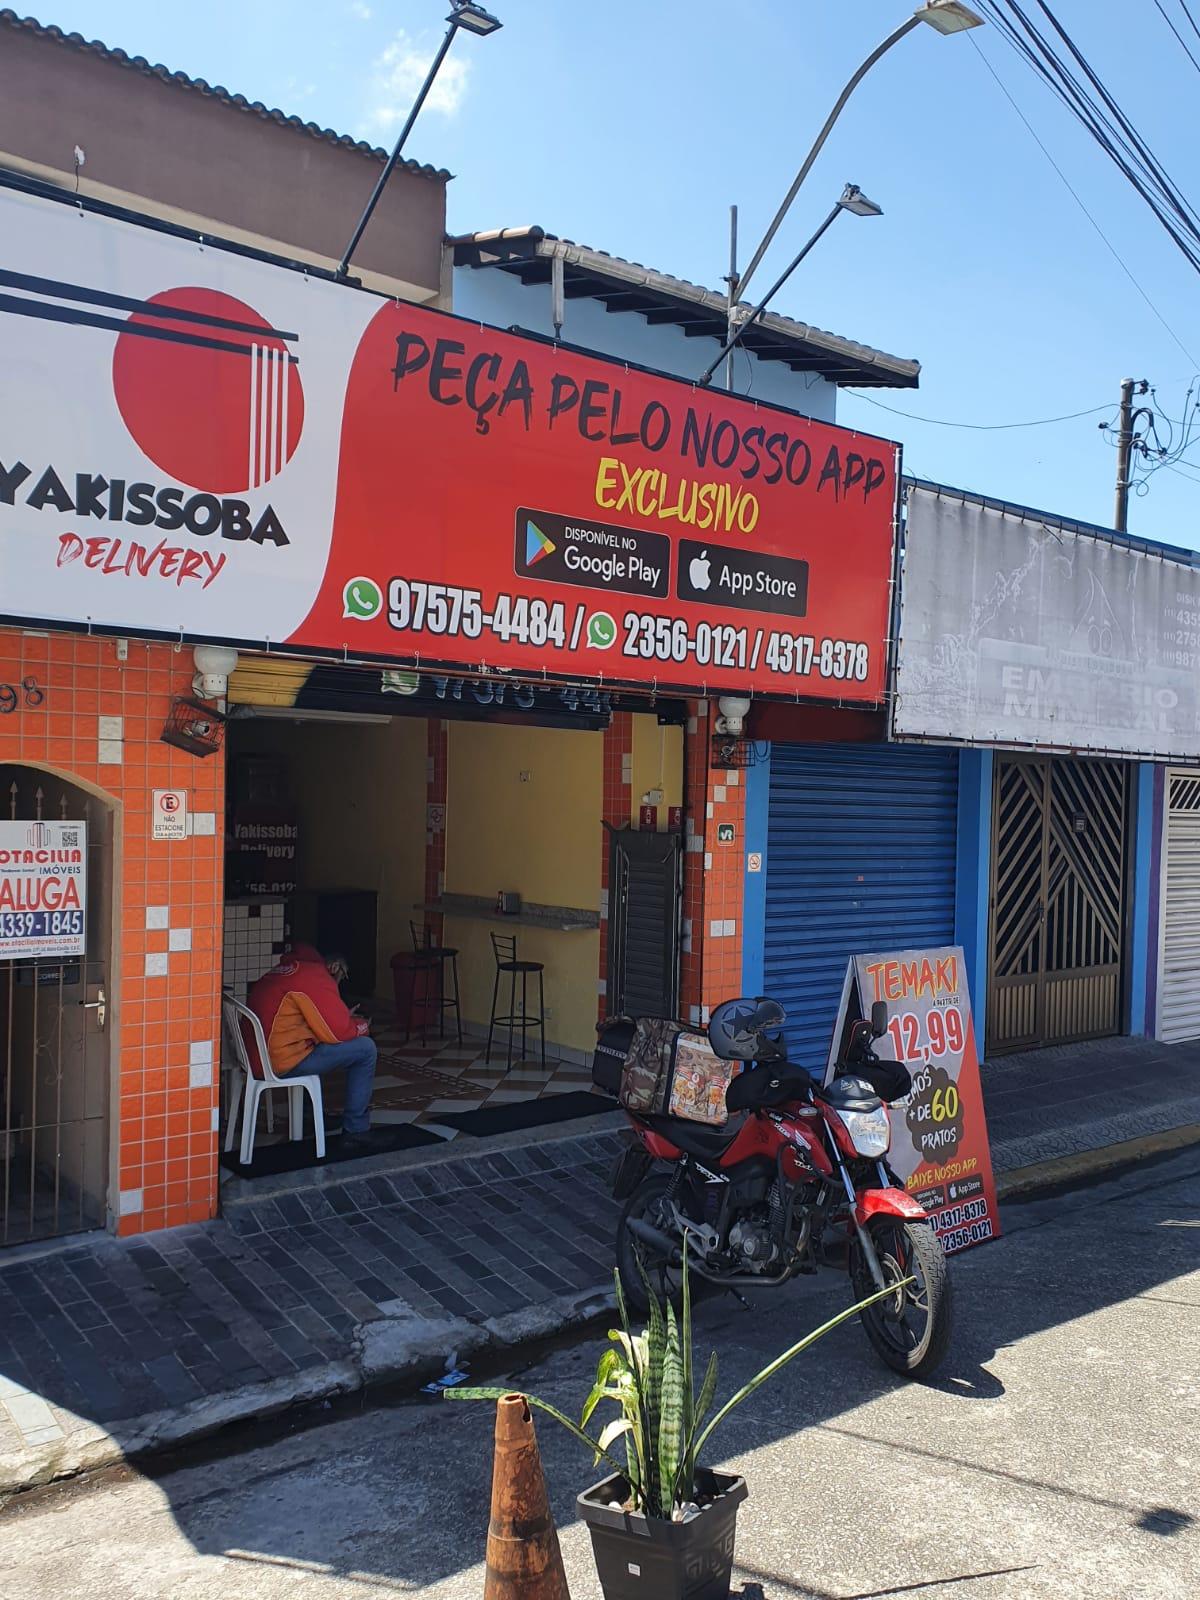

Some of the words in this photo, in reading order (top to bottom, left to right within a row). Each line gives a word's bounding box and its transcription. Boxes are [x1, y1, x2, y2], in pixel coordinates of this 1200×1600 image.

[392, 331, 535, 435] PEÇA
[548, 373, 672, 452] PELO
[681, 408, 813, 487] NOSSO
[816, 444, 886, 504] APP
[0, 461, 290, 547] YAKISSOBA
[594, 456, 760, 534] EXCLUSIVO
[563, 525, 620, 551] DISPONÍVEL
[621, 537, 637, 551] NO
[56, 532, 227, 589] DELIVERY
[563, 545, 626, 583] Google
[627, 551, 662, 588] Play
[718, 564, 754, 596] App
[755, 569, 797, 598] Store
[387, 578, 567, 649] 97575-4484
[622, 612, 748, 670] 2356-0121
[764, 630, 869, 682] 4317-8378
[39, 865, 81, 875] IMÓVEIS
[0, 876, 80, 911] ALUGA
[866, 955, 958, 1001] TEMAKI
[887, 1006, 965, 1064] 12,99
[904, 1067, 932, 1108] EMOS
[917, 1104, 932, 1121] DE
[931, 1086, 959, 1122] 60
[921, 1127, 957, 1150] PRATOS
[907, 1169, 934, 1190] BAIXE
[934, 1162, 961, 1181] NOSSO
[962, 1158, 977, 1171] APP
[958, 1184, 968, 1194] App
[967, 1180, 981, 1191] Store
[939, 1198, 988, 1229] 4317-8378
[943, 1218, 994, 1253] 2356-0121
